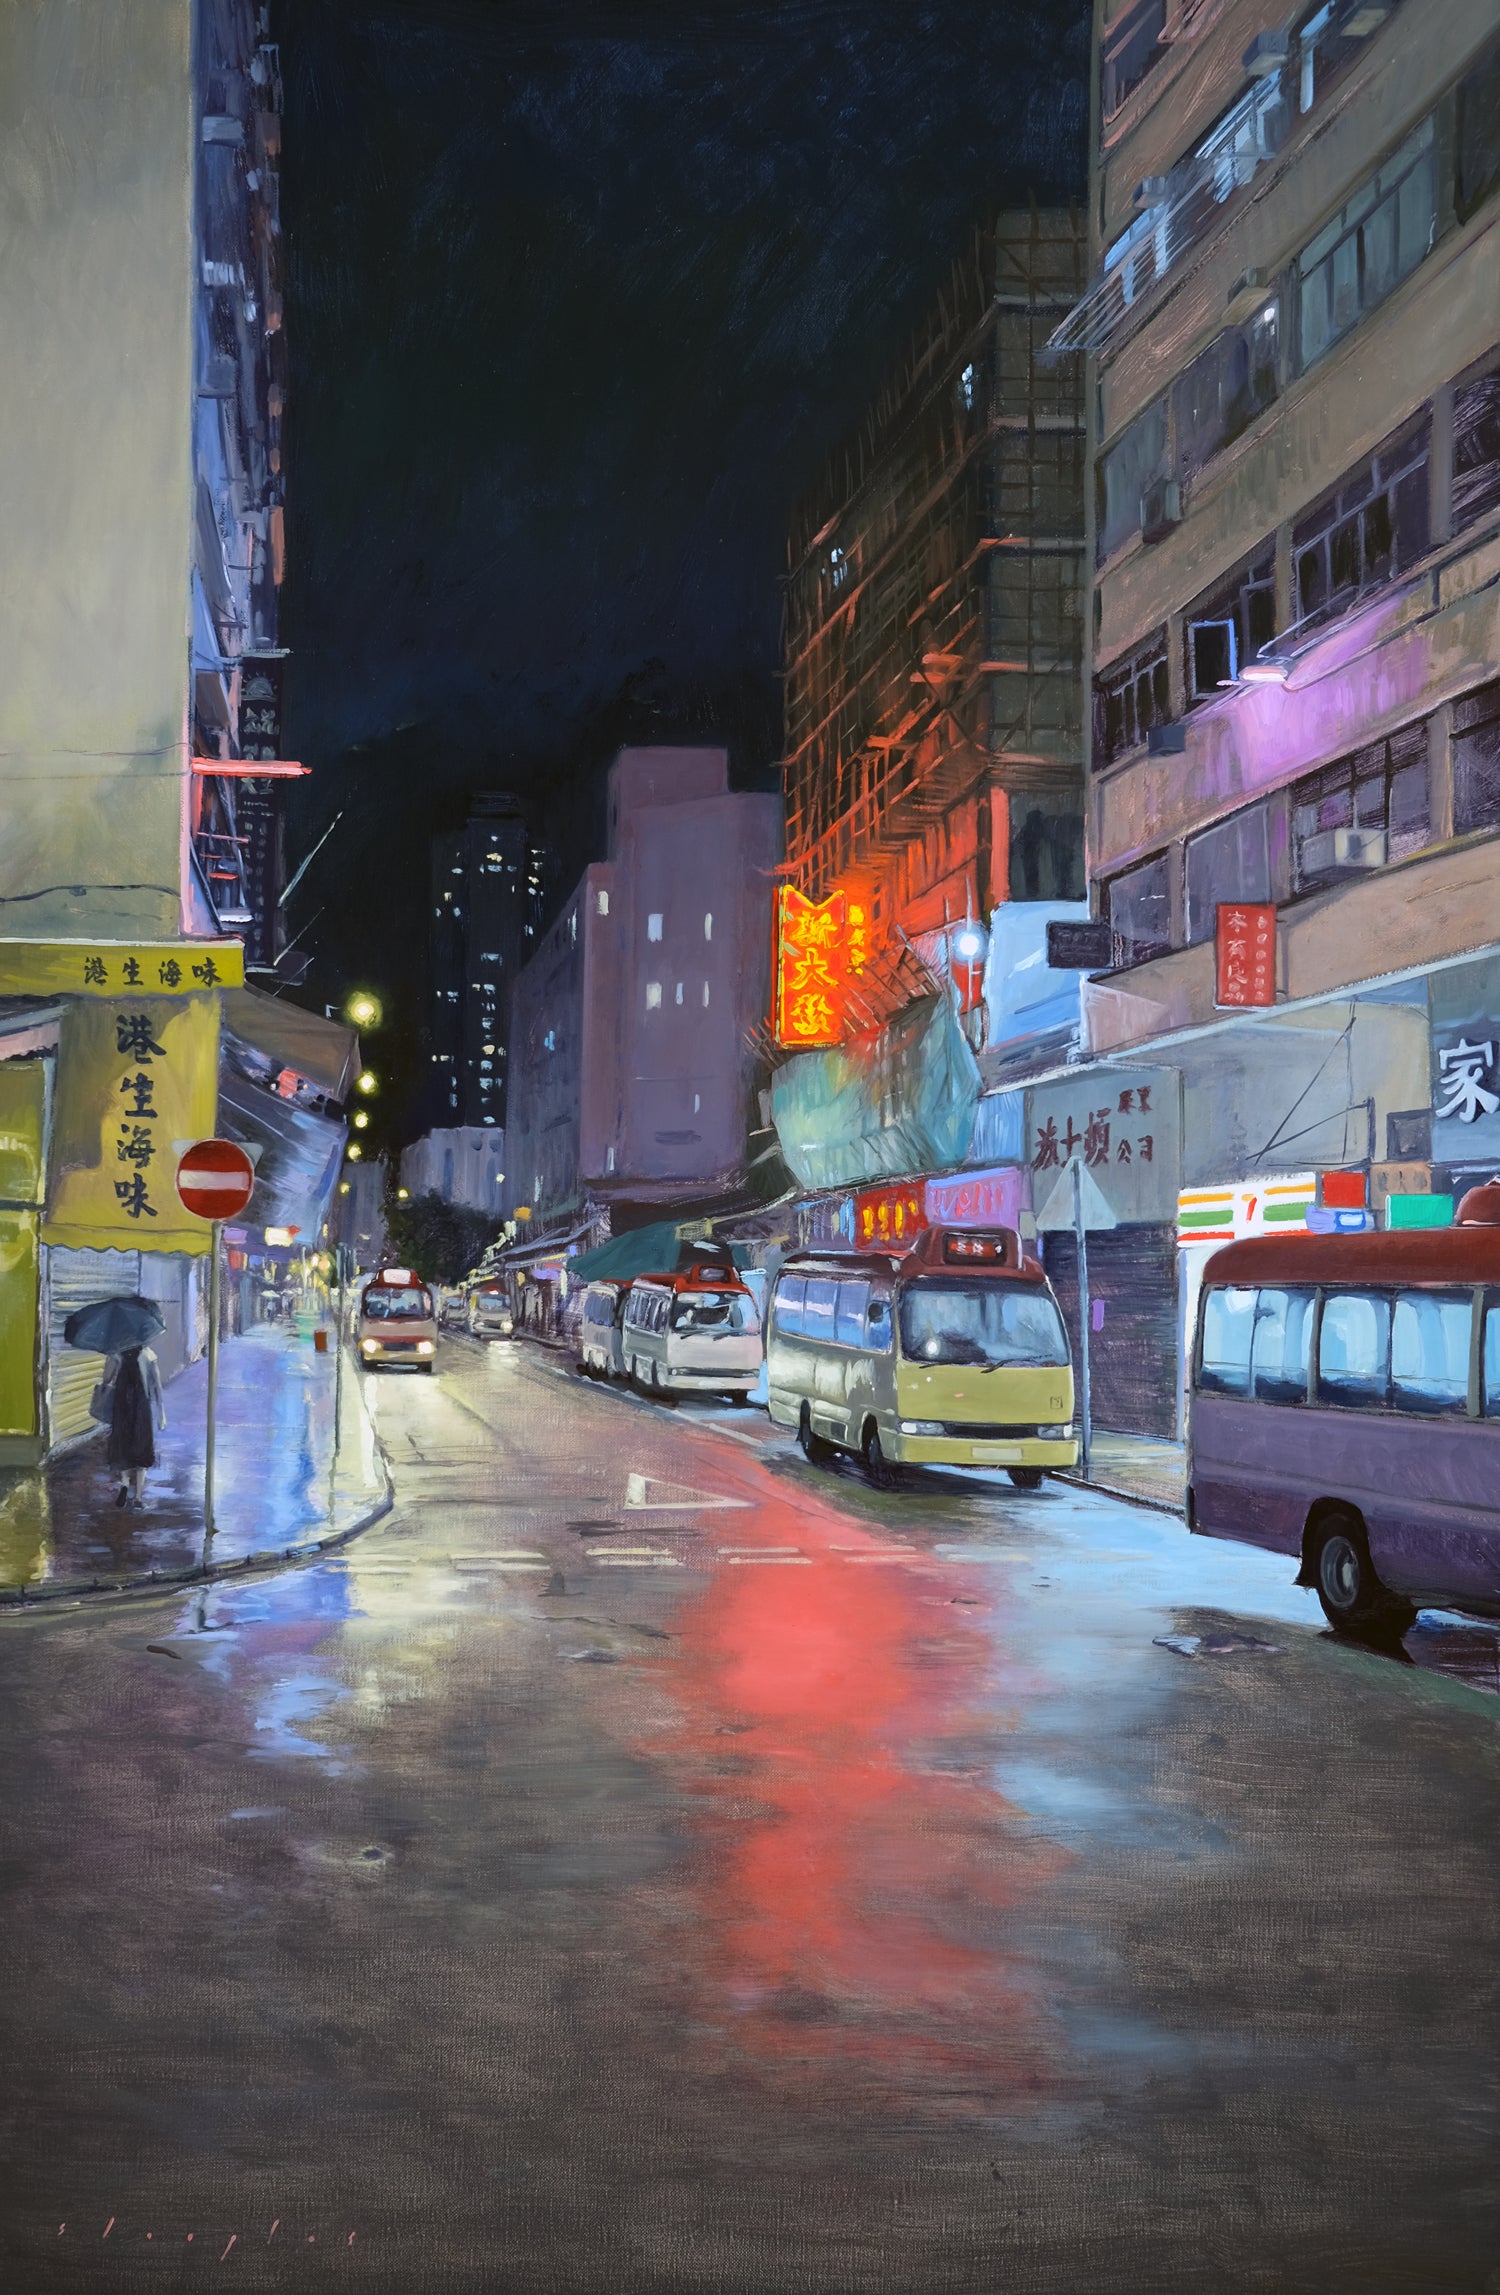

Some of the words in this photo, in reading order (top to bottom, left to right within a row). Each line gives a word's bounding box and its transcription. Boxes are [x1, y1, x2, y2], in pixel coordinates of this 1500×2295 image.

[84, 956, 223, 988] 港生海味
[114, 1014, 167, 1219] 港生海味
[1435, 1038, 1500, 1123] 家
